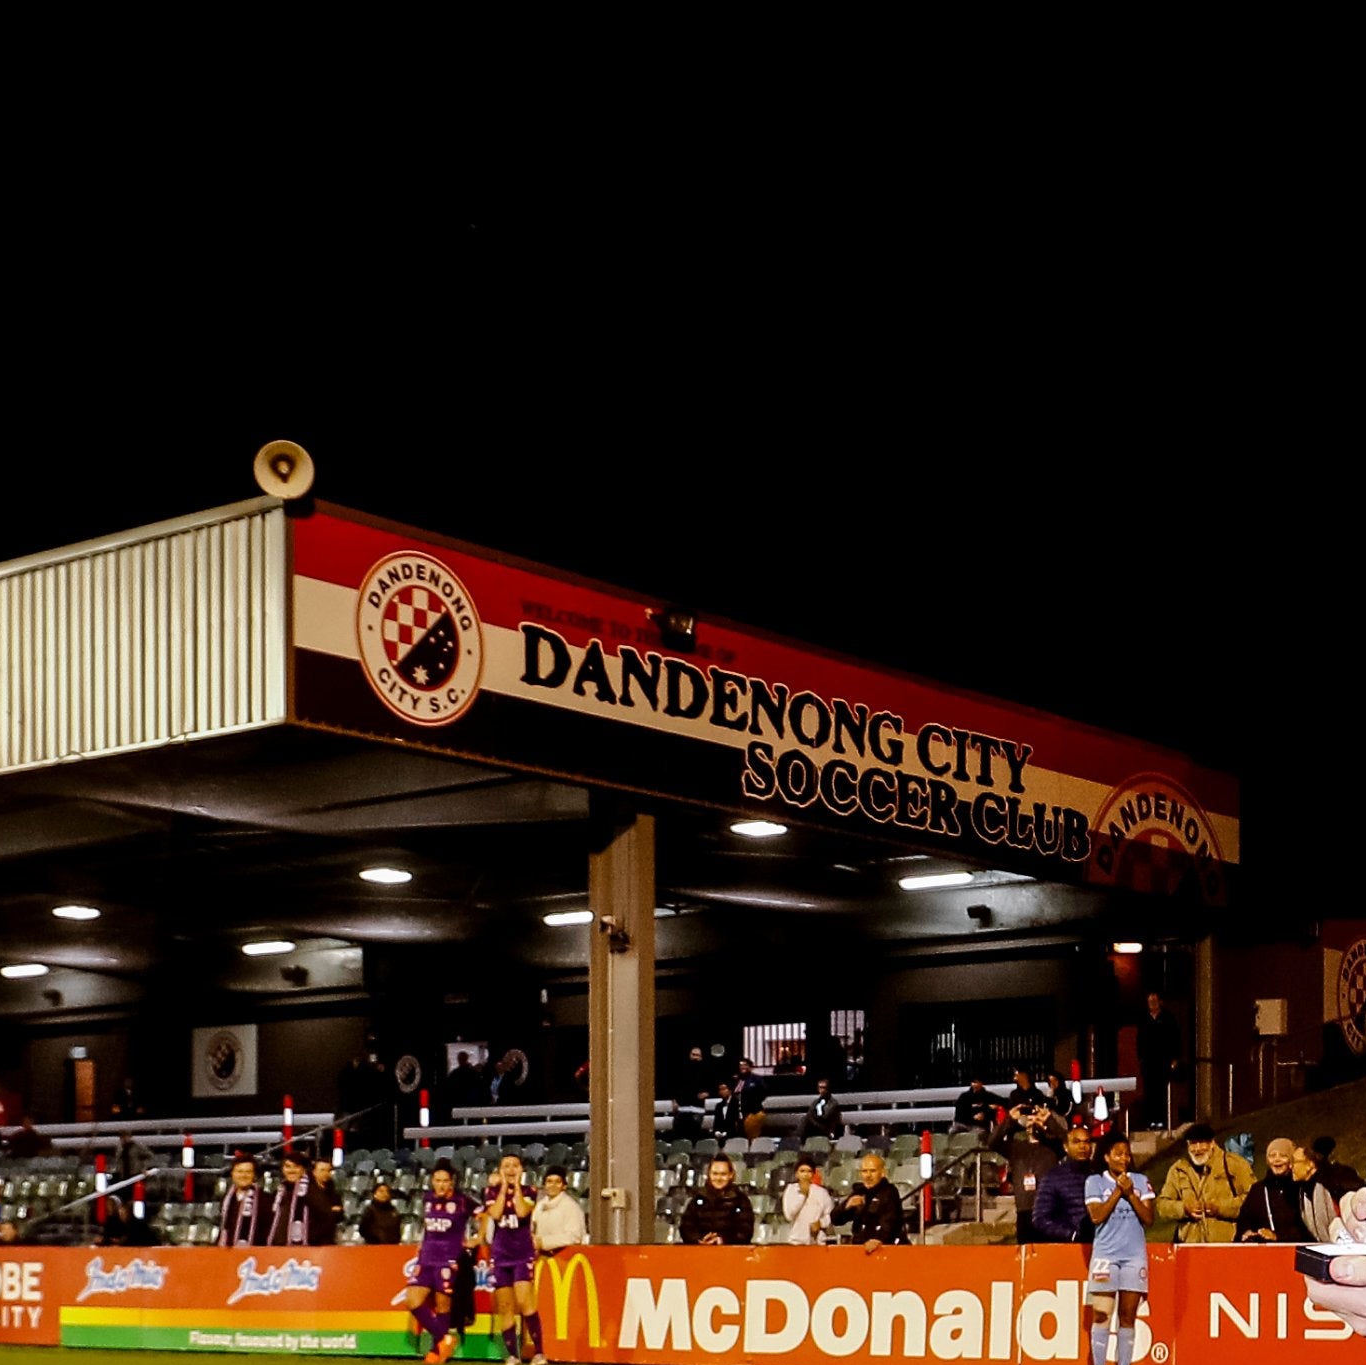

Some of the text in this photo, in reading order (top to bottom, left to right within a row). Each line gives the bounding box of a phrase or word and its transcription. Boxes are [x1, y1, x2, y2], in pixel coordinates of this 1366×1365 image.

[367, 562, 474, 633] DANDENONG
[377, 666, 422, 713] CITY
[519, 622, 1033, 794] DANDENONG CITY
[742, 741, 1092, 862] SOCCER CLUB
[1092, 1258, 1110, 1273] 22
